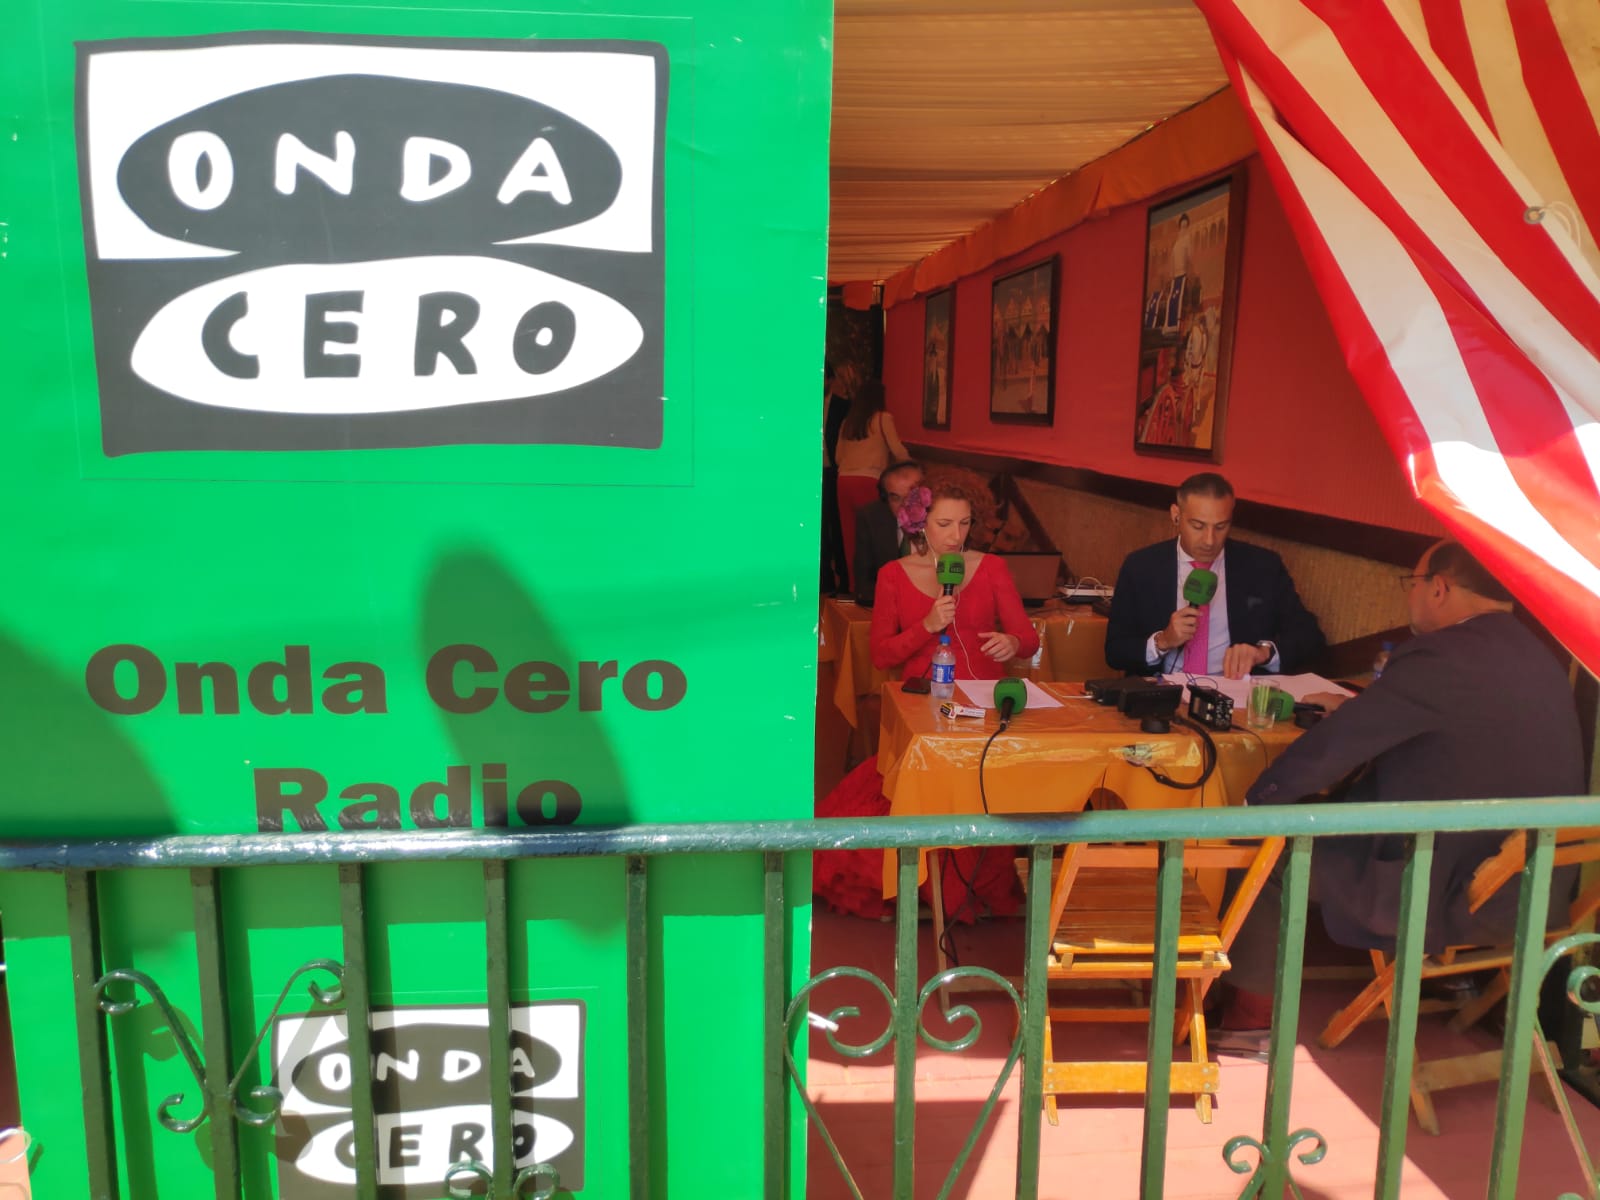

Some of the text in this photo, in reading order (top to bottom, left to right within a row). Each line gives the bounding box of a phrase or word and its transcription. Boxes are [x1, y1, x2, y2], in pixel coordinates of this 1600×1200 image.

[168, 130, 572, 211] ONDA
[201, 290, 577, 380] CERO
[85, 643, 688, 715] Onda Cero
[253, 763, 583, 832] Radio
